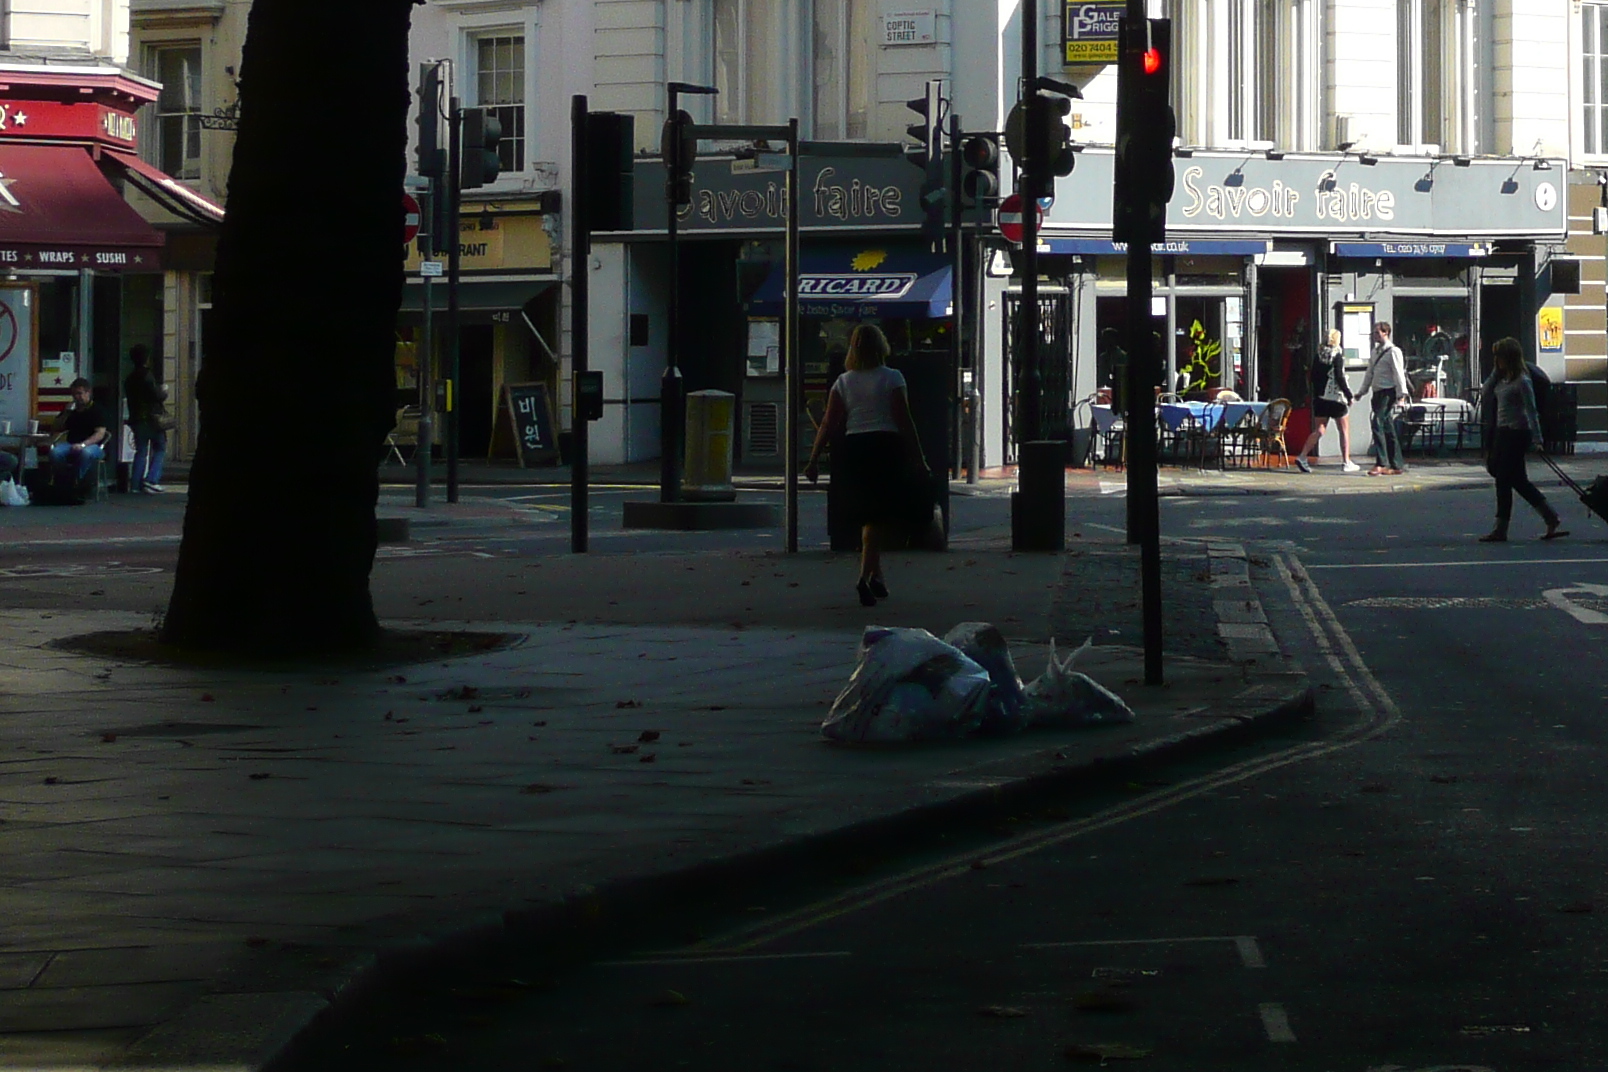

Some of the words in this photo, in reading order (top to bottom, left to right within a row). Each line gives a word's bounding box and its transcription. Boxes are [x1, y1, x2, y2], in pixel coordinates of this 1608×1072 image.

[1080, 4, 1120, 25] GALE
[887, 21, 915, 31] COPTIC
[1073, 16, 1119, 39] PRIGG
[887, 31, 916, 42] STREET
[1069, 43, 1087, 53] 020
[812, 167, 901, 221] faire
[1182, 166, 1300, 220] Savoir
[1314, 169, 1395, 221] faire
[38, 251, 75, 263] WRAPS
[95, 253, 126, 264] SUSHI
[798, 278, 898, 294] RICARD
